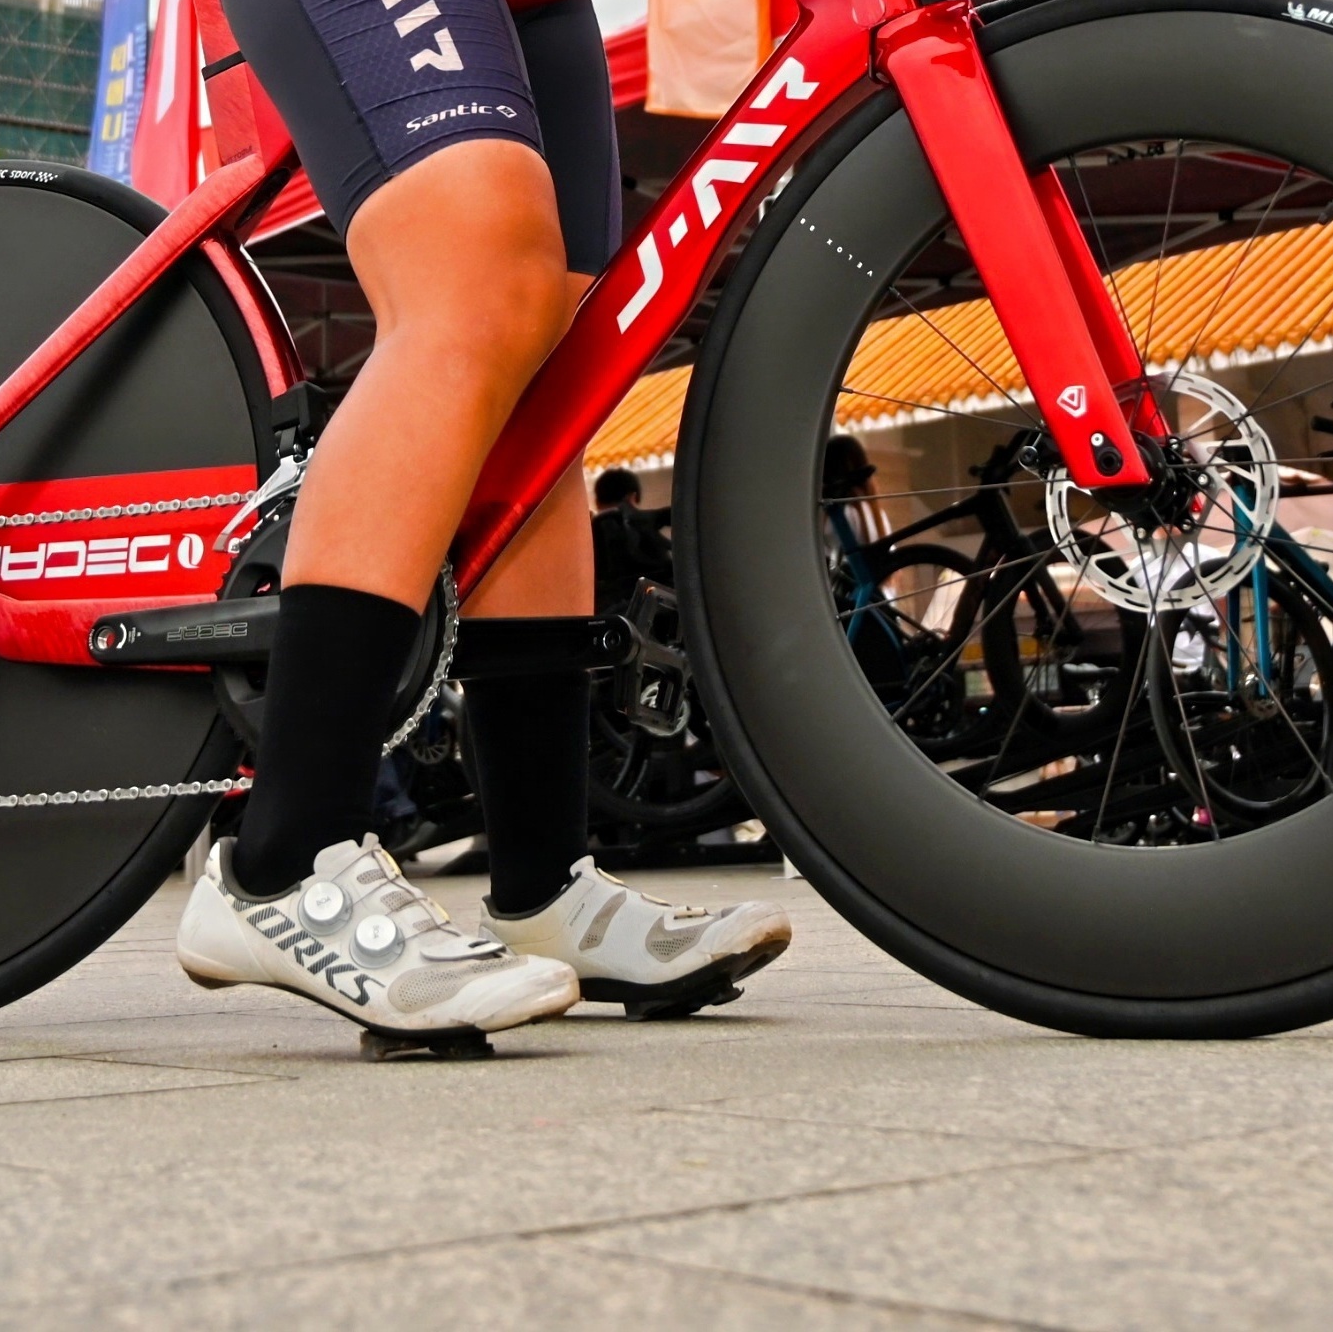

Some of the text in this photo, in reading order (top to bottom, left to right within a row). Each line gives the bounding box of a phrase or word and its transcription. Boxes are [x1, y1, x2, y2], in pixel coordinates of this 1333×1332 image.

[9, 169, 36, 180] sport
[826, 238, 874, 278] VELOX
[233, 899, 387, 1006] ORKS
